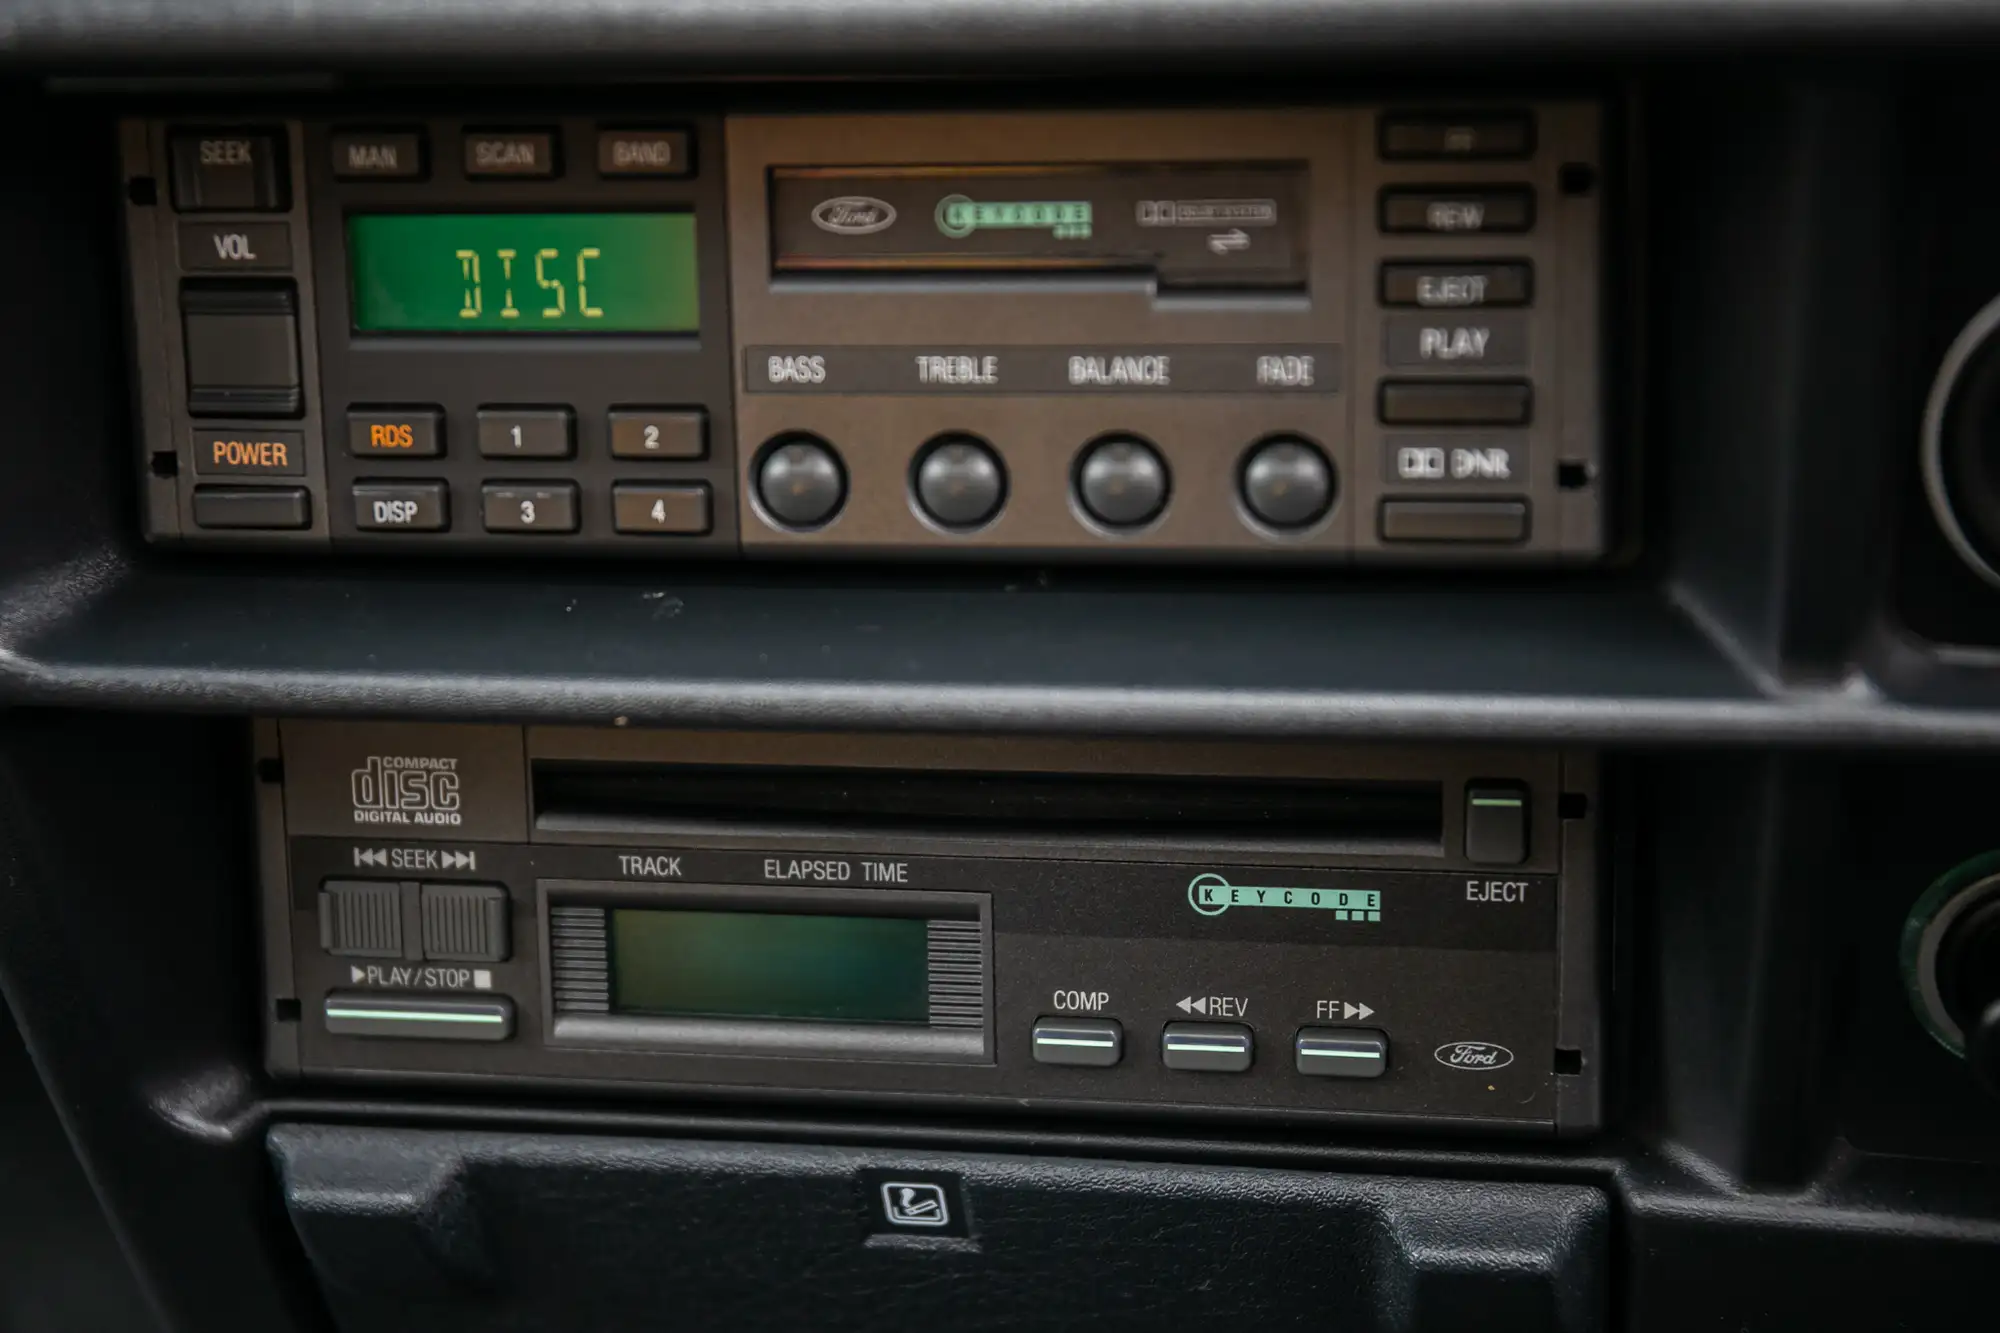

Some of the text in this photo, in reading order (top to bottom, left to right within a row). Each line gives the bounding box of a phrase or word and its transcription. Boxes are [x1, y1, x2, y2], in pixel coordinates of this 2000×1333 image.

[200, 140, 252, 165] SEEK
[348, 145, 397, 168] MAN
[475, 141, 535, 166] SCAN
[213, 234, 256, 260] VOL
[455, 249, 603, 318] DISC
[1420, 327, 1490, 360] PLAY
[768, 355, 826, 384] BASS
[916, 355, 999, 385] TREBLE
[1068, 355, 1171, 386] BALANCE
[1256, 355, 1315, 386] FADE
[370, 424, 413, 448] RDS
[510, 425, 522, 448] 1
[643, 425, 660, 449] 2
[213, 441, 288, 467] POWER
[373, 501, 419, 524] DISP
[519, 501, 536, 524] 3
[649, 500, 666, 524] 4
[383, 756, 458, 770] COMPACT
[354, 810, 462, 825] DIGITAL AUDIO
[391, 847, 438, 869] SEEK
[619, 855, 682, 878] TRACK
[764, 859, 908, 883] ELAPSED TIME
[1203, 888, 1376, 907] KEYCODE
[1466, 881, 1529, 903] EJECT
[368, 967, 470, 989] PLAY/STOP
[1053, 991, 1109, 1012] COMP
[1209, 997, 1248, 1018] REV
[1316, 1001, 1340, 1019] FF
[1449, 1044, 1498, 1067] Ford
